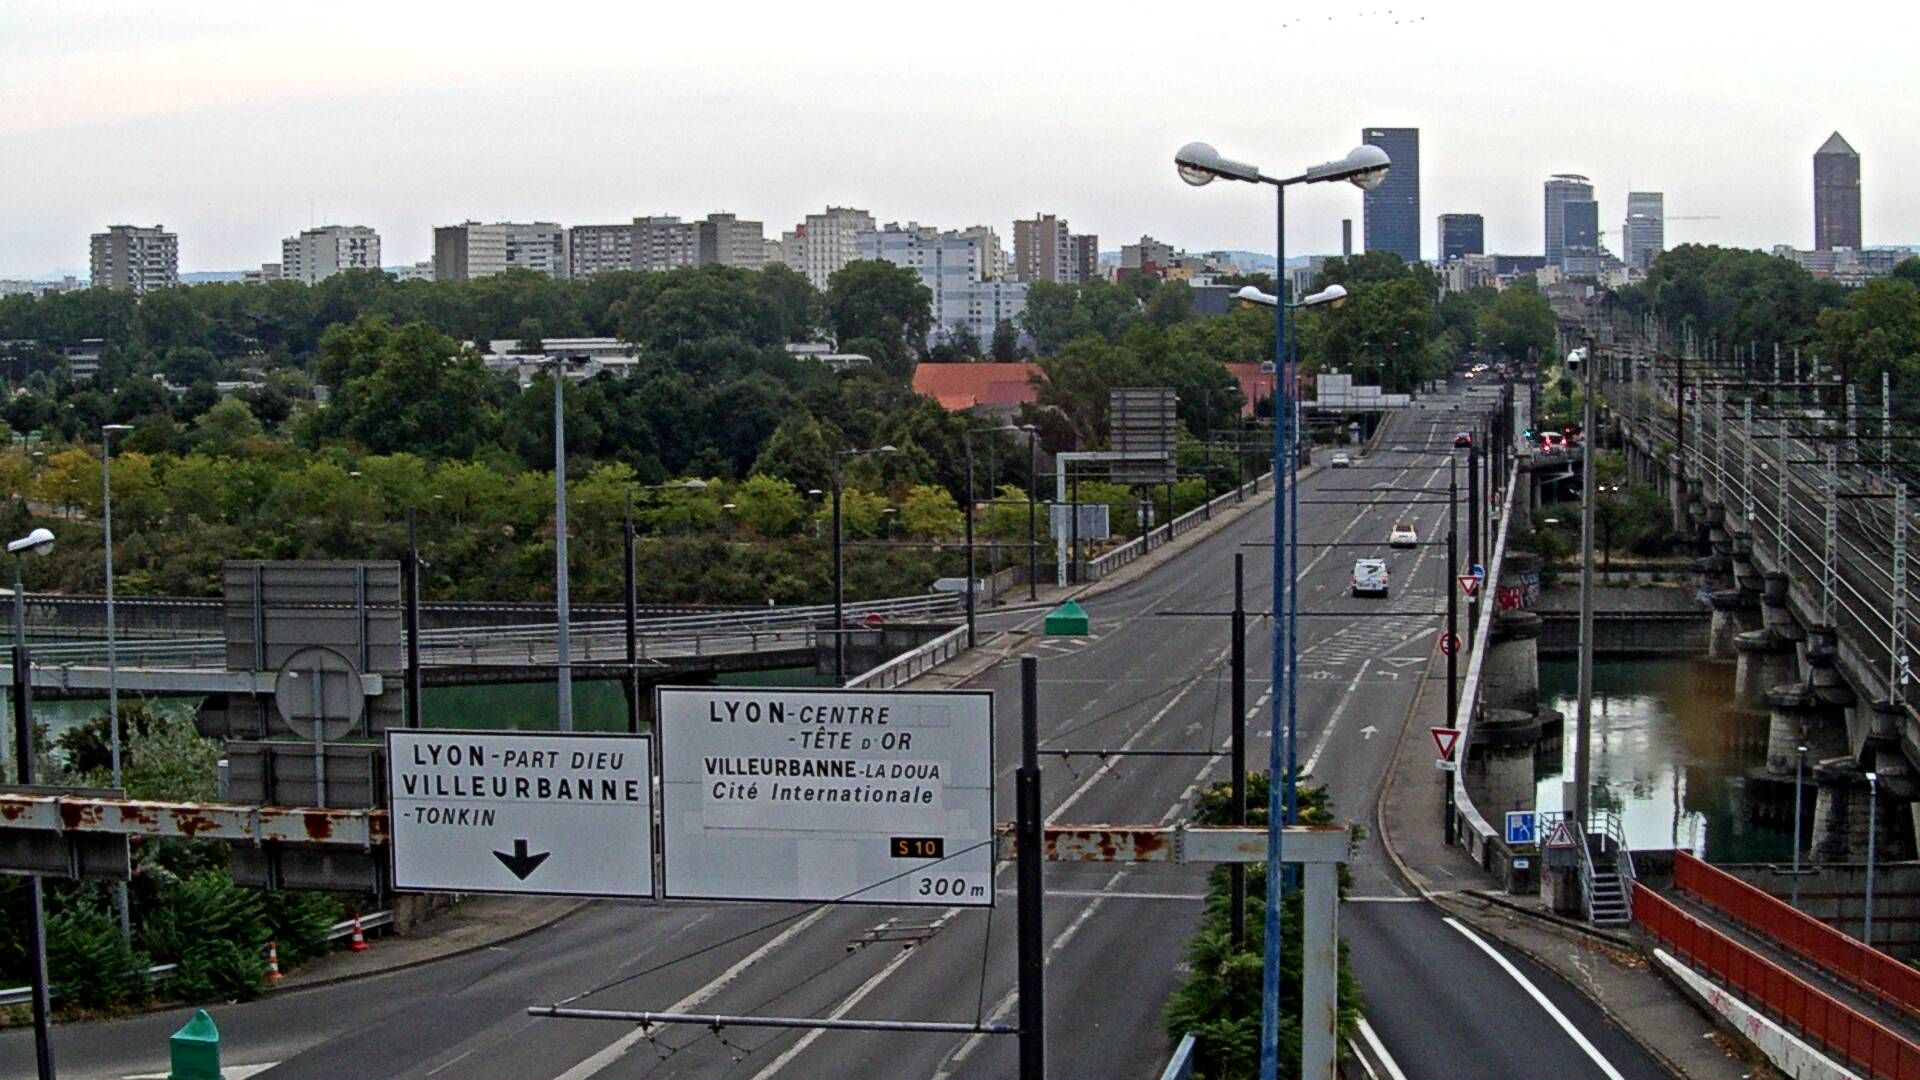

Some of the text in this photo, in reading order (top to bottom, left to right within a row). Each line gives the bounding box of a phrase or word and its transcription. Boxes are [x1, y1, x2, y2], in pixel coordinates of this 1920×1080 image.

[571, 752, 624, 770] DIEU
[891, 764, 940, 780] DOUA
[402, 774, 639, 801] VILLEURBANNE
[712, 781, 933, 804] Cité Internationale
[899, 840, 936, 856] S 10
[918, 877, 984, 897] 300 m
